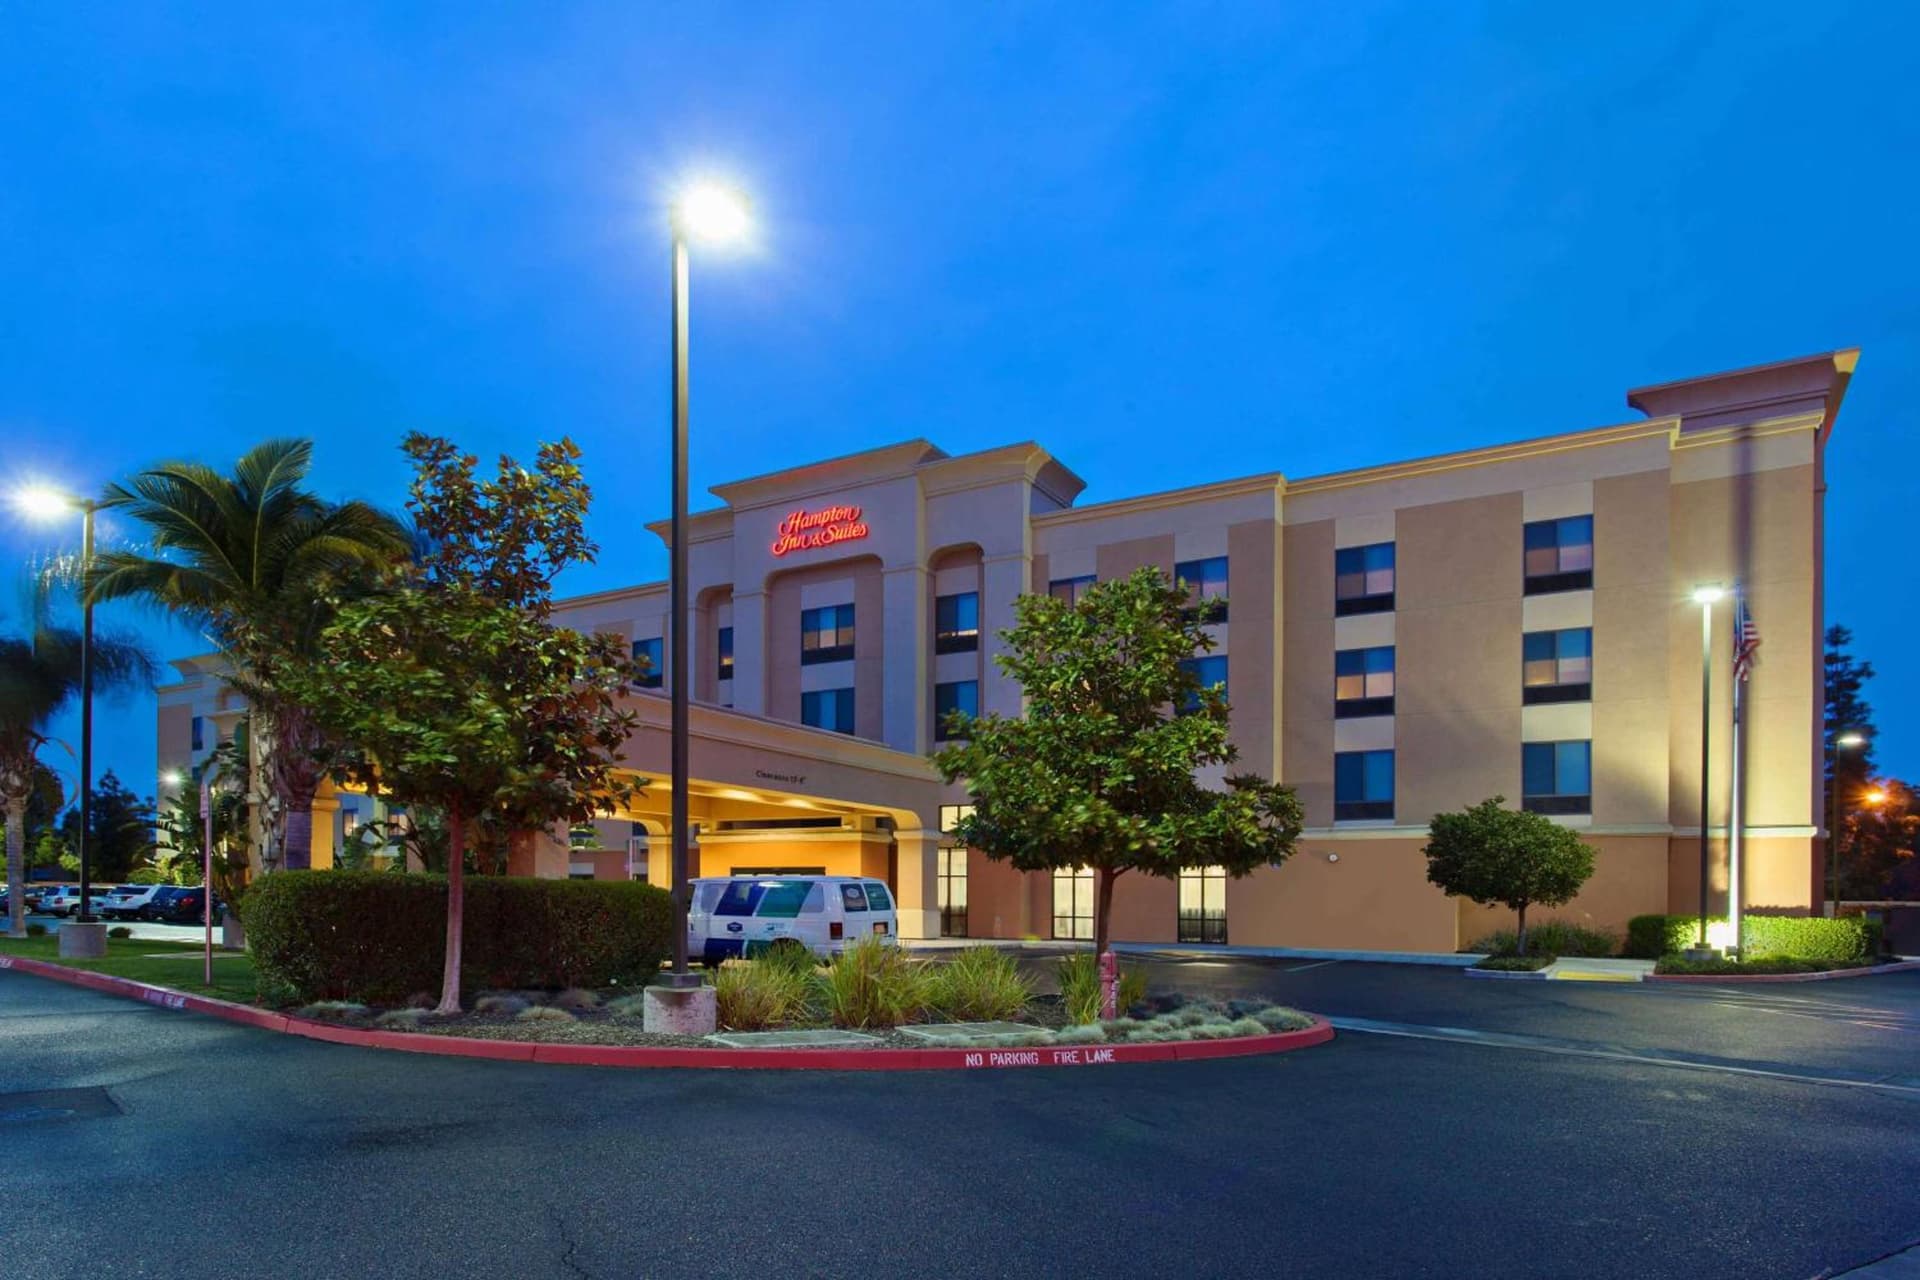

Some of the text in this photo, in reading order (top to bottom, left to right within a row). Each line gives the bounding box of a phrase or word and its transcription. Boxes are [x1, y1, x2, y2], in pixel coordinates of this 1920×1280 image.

[779, 506, 862, 534] Hampton
[772, 522, 869, 555] Inn & Suites
[965, 1049, 1116, 1067] NO PARKING FIRE LANE
